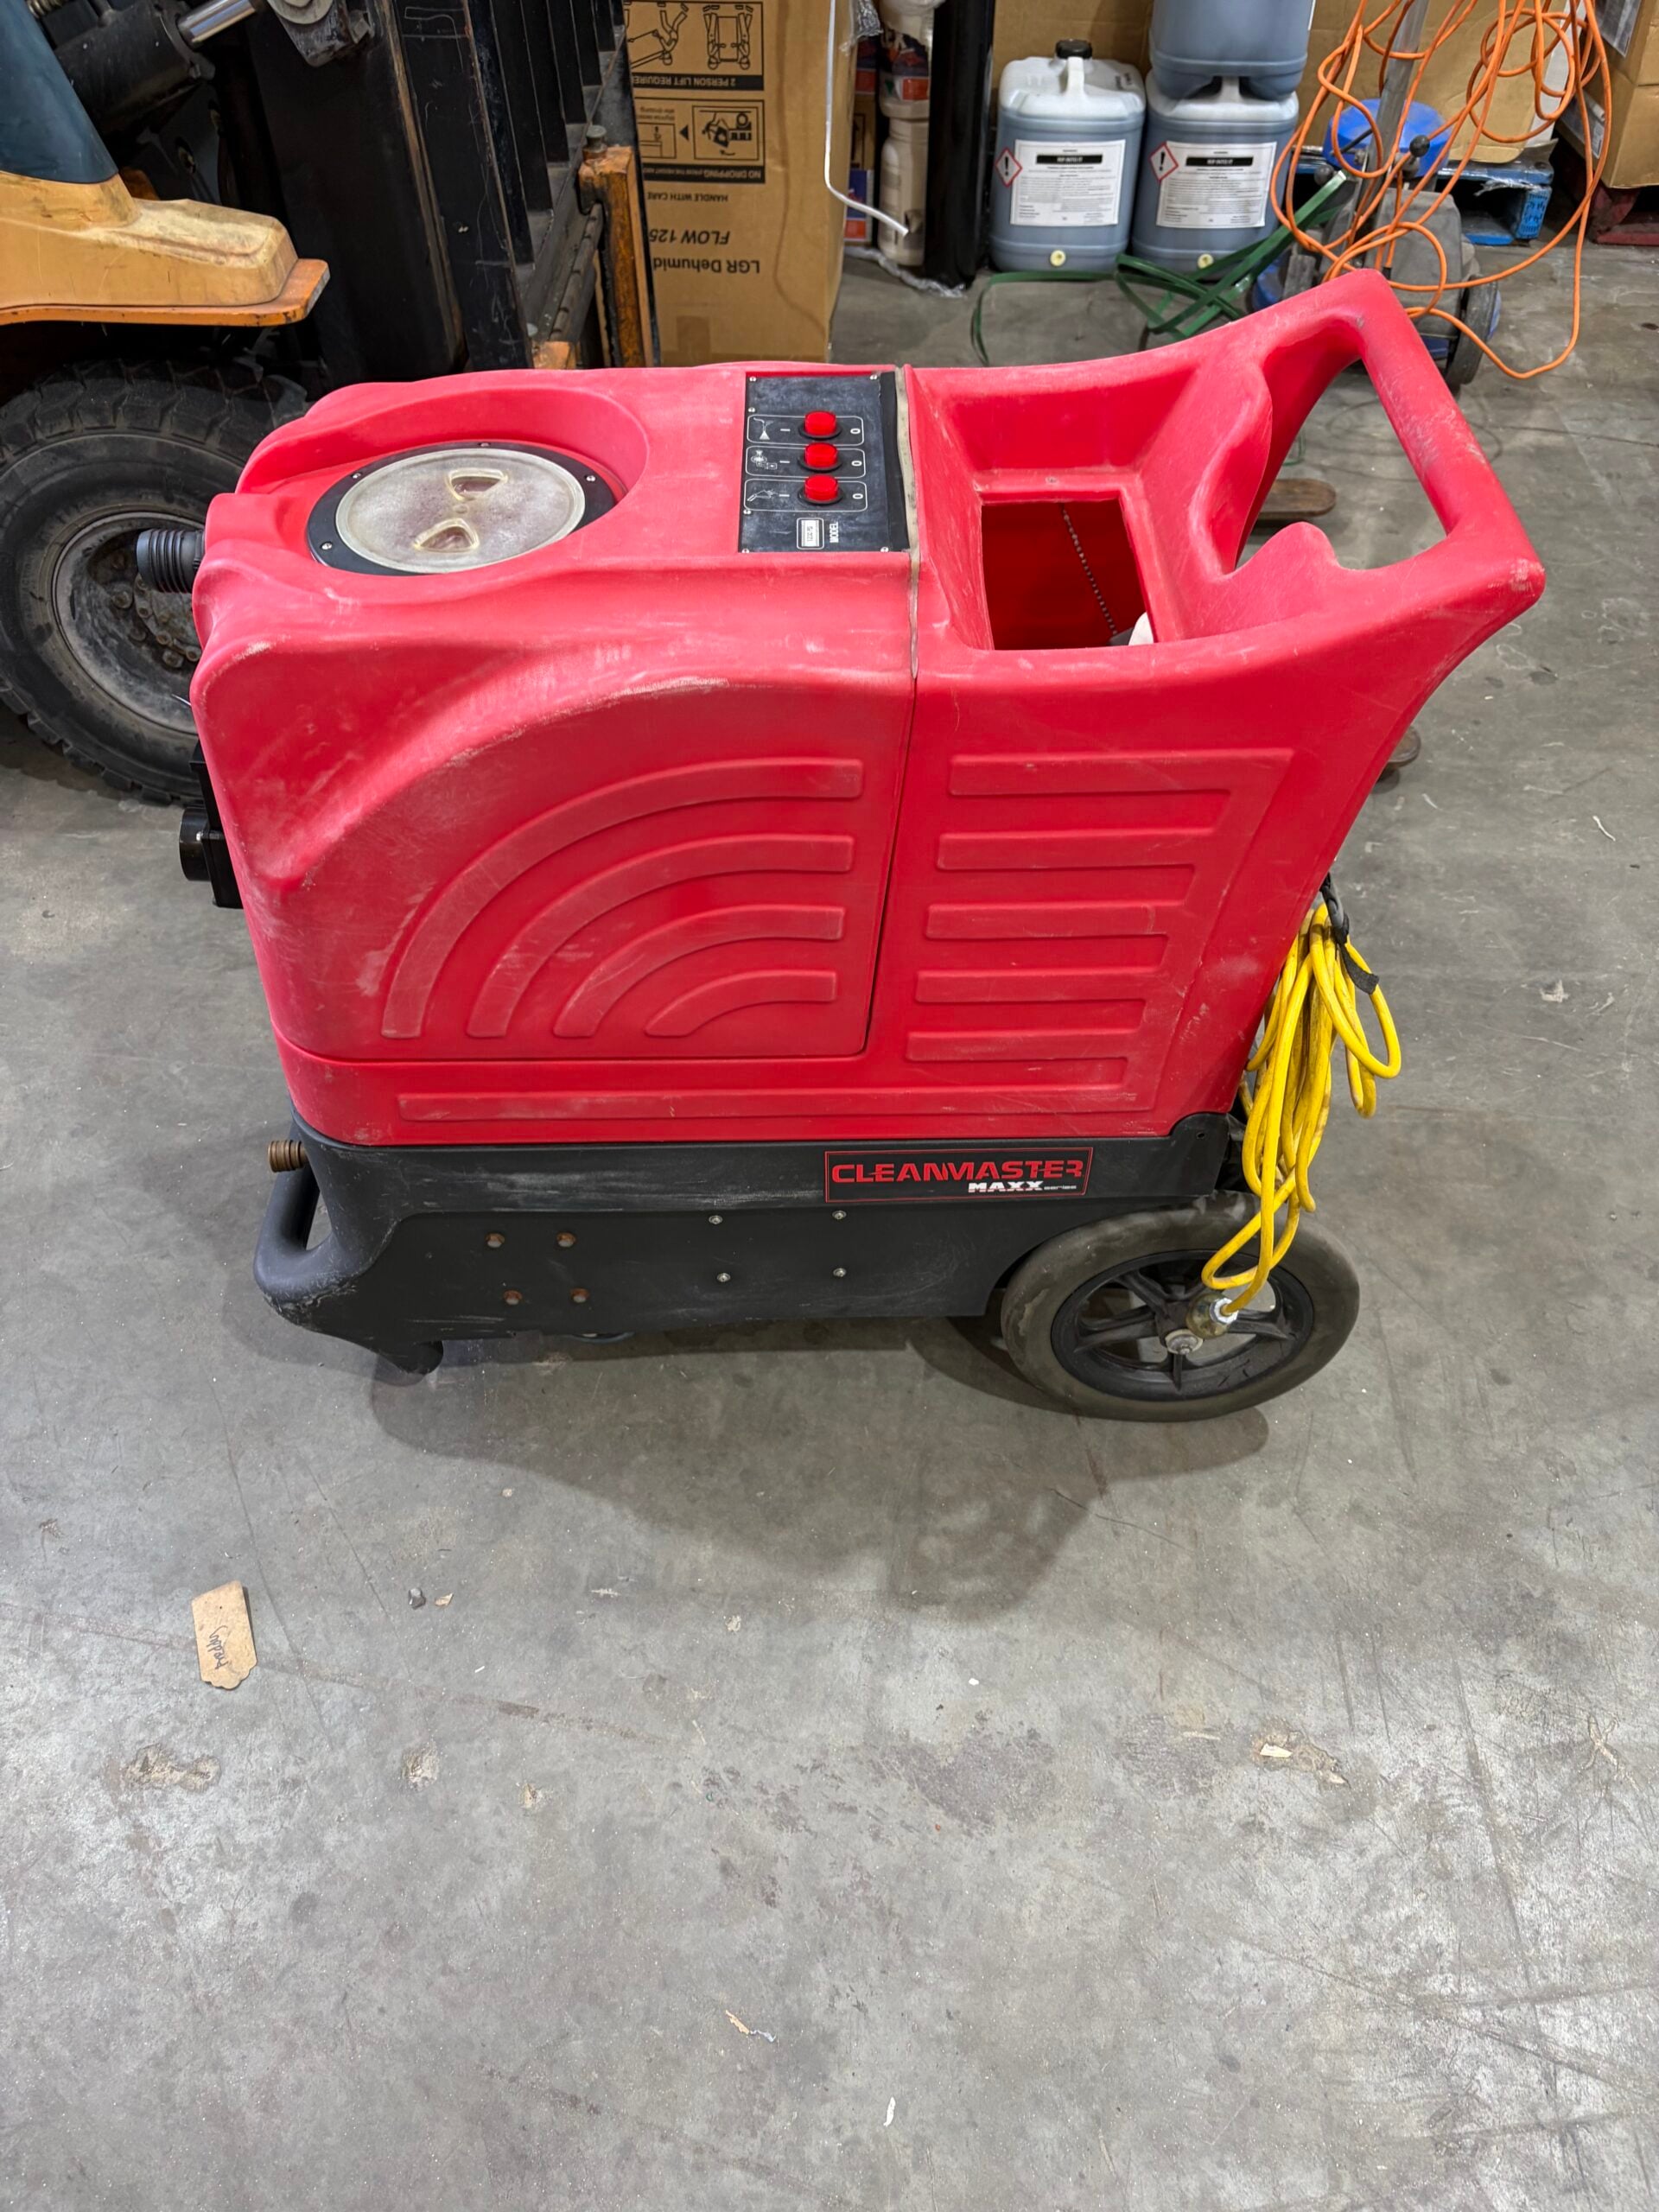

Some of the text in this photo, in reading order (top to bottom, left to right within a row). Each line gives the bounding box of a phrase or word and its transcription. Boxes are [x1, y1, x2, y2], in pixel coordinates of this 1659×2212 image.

[674, 76, 692, 86] LIFT
[694, 77, 728, 86] PERSON
[704, 168, 747, 179] DROPPING
[747, 170, 761, 179] NO
[646, 192, 728, 202] HANDLE WITH CARE
[649, 228, 730, 245] FLOW 125
[727, 259, 760, 274] LGR
[831, 1160, 1084, 1183] CLEANMASTER
[968, 1180, 1044, 1193] MAXX
